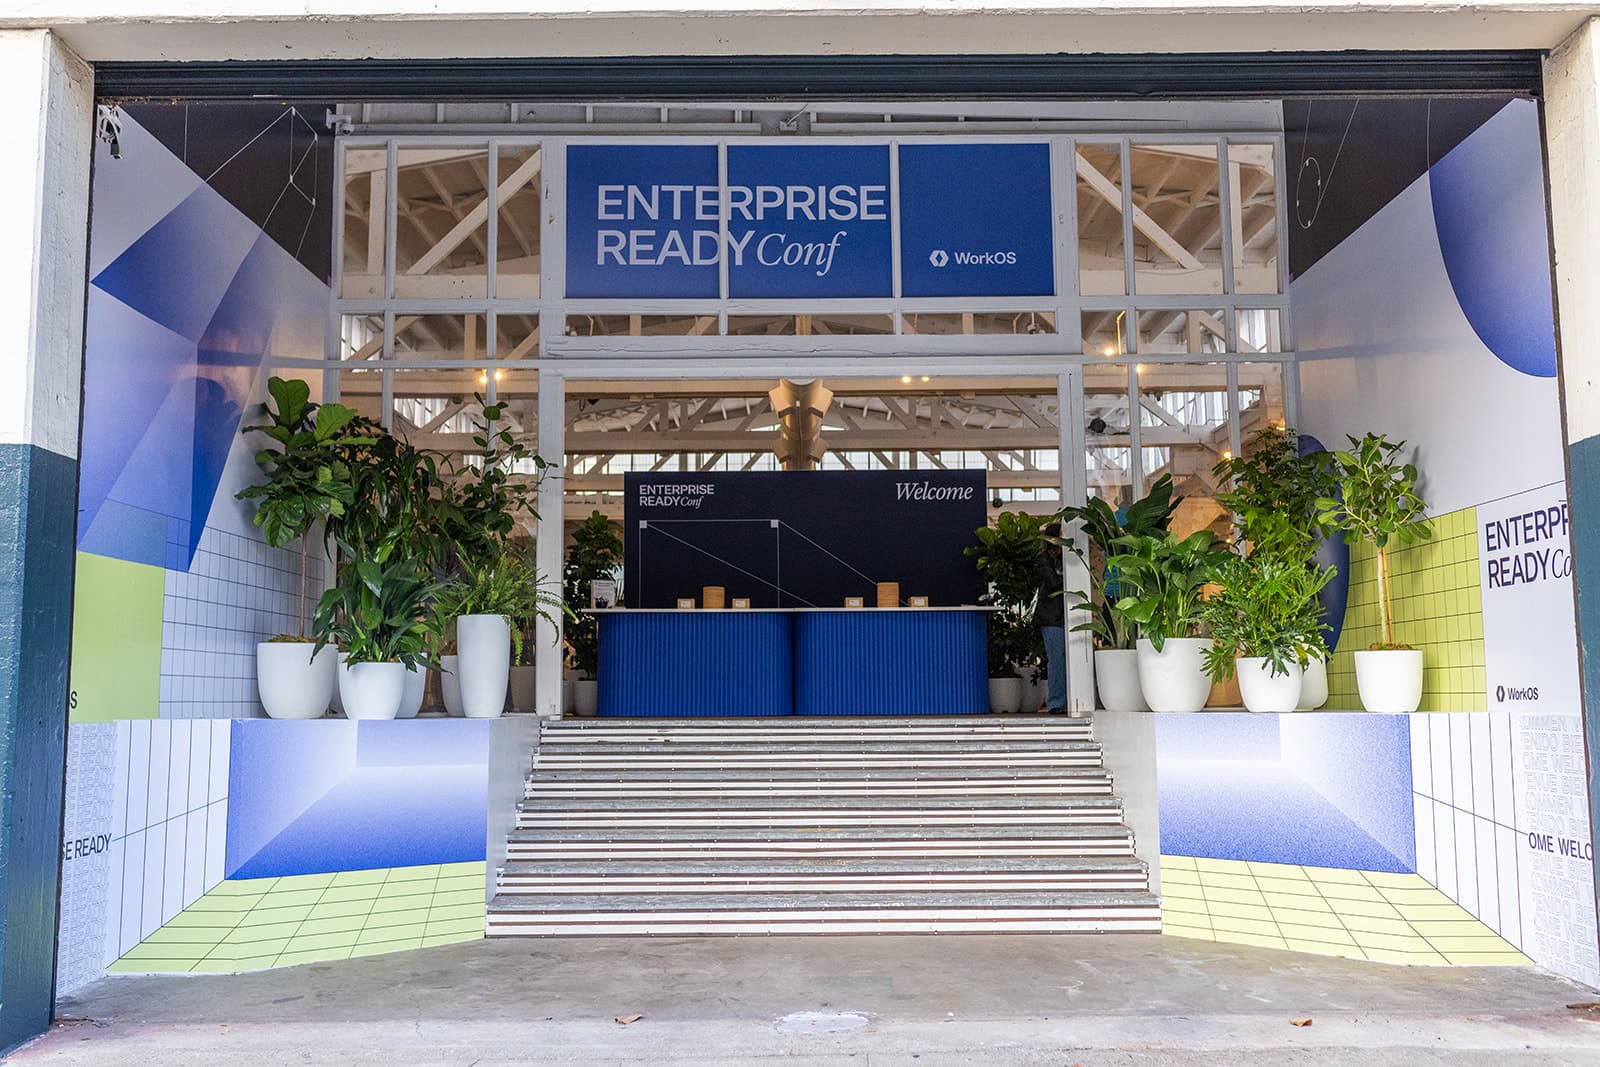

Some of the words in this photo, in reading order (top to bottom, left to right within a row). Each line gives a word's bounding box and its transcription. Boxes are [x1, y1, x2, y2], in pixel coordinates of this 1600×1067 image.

[597, 184, 887, 221] ENTERPRISE
[597, 230, 755, 266] READY
[757, 231, 846, 277] Conf
[954, 252, 1017, 266] WorkOS
[639, 484, 715, 495] ENTERPRISE
[895, 481, 974, 501] Welcome
[639, 496, 680, 507] READY
[680, 496, 703, 509] Conf
[1488, 549, 1551, 589] READY
[1508, 687, 1538, 701] WorkOS
[75, 832, 112, 858] READY
[1529, 832, 1554, 853] OME
